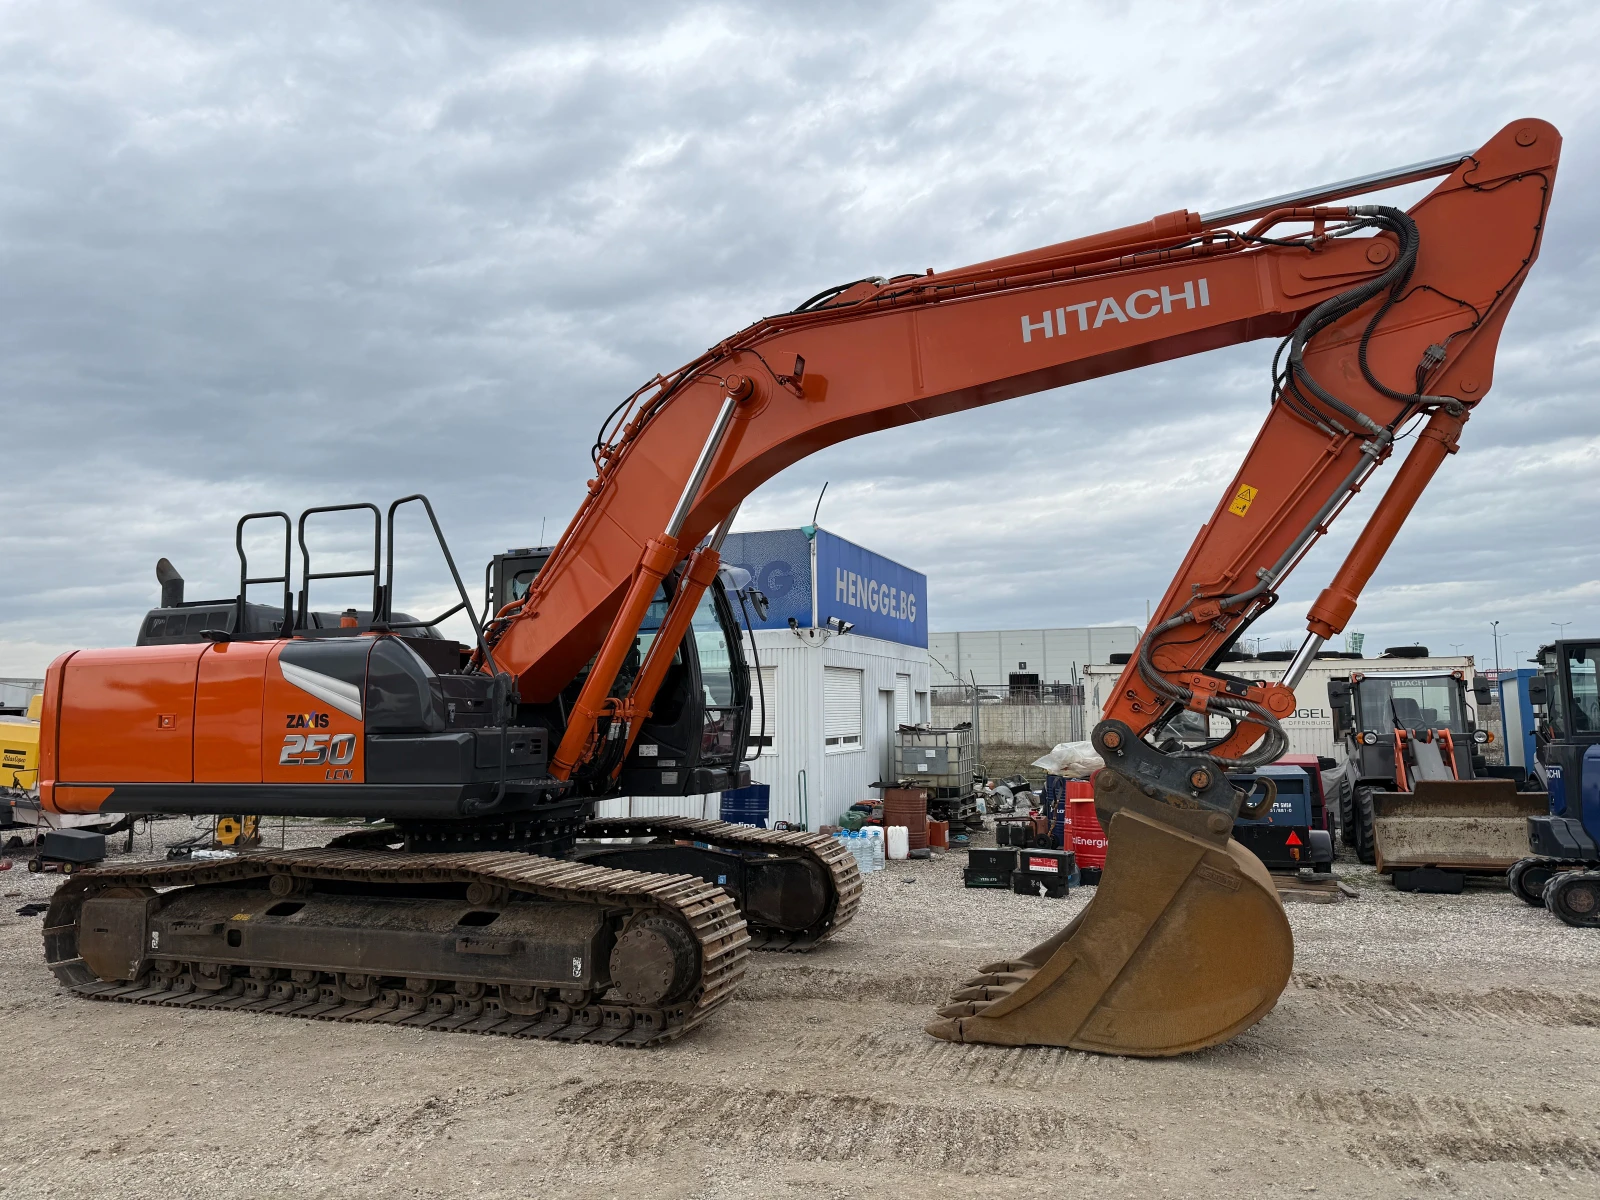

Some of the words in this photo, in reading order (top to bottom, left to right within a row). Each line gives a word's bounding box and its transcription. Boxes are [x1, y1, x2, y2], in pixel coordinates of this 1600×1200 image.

[1021, 278, 1210, 343] HITACHI
[836, 567, 916, 623] HENGGE.BG
[286, 711, 329, 728] ZAXIS
[1287, 708, 1330, 719] OGEL
[279, 734, 356, 765] 250
[325, 769, 353, 780] LCN
[1545, 769, 1561, 779] ACHI
